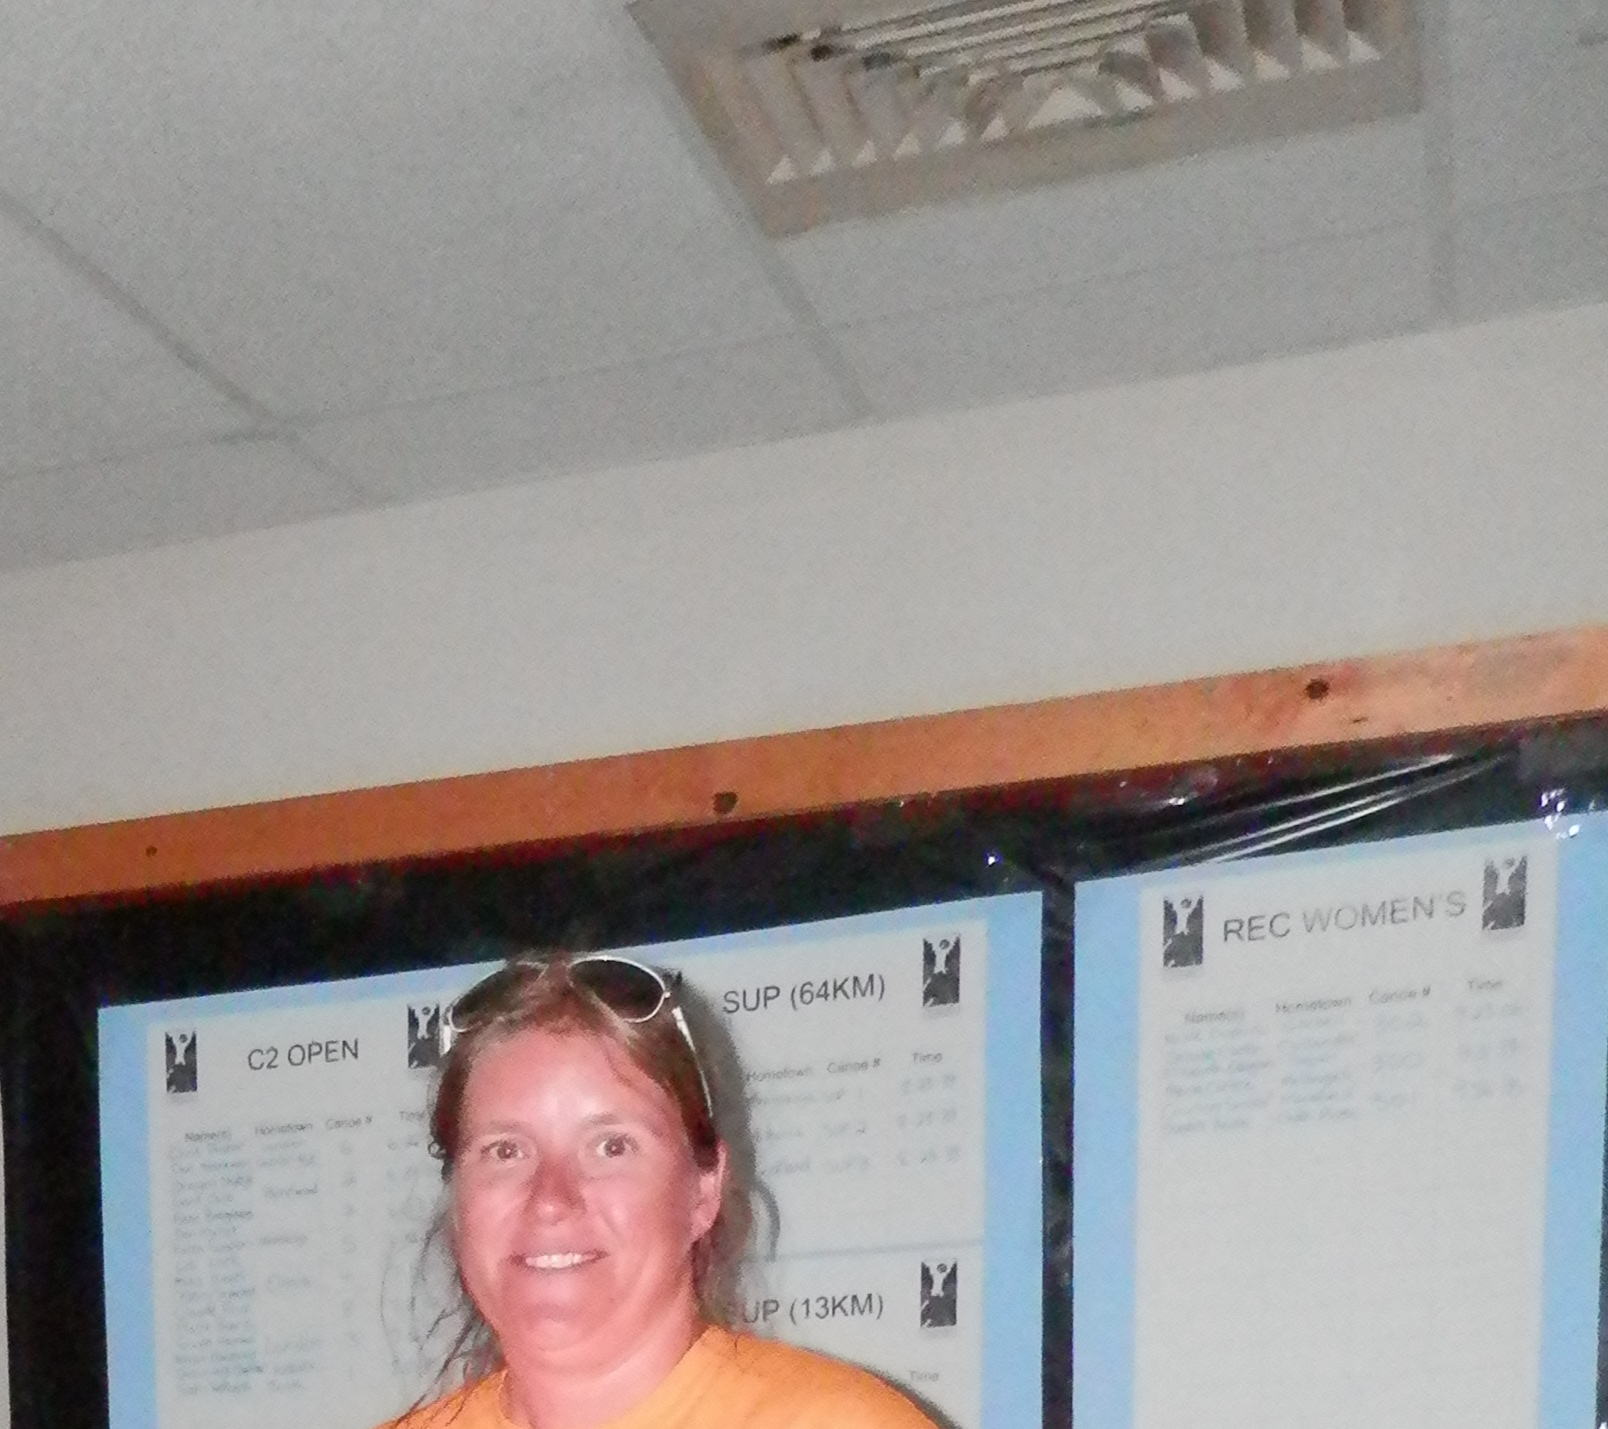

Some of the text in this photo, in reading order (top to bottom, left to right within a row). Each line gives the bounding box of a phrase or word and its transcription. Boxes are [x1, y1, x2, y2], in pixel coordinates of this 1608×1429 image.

[1222, 889, 1467, 943] REC WOMEN'S
[722, 972, 886, 1014] SUP (64KM)
[247, 1038, 360, 1071] C2 OPEN
[789, 1292, 884, 1324] (13KM)
